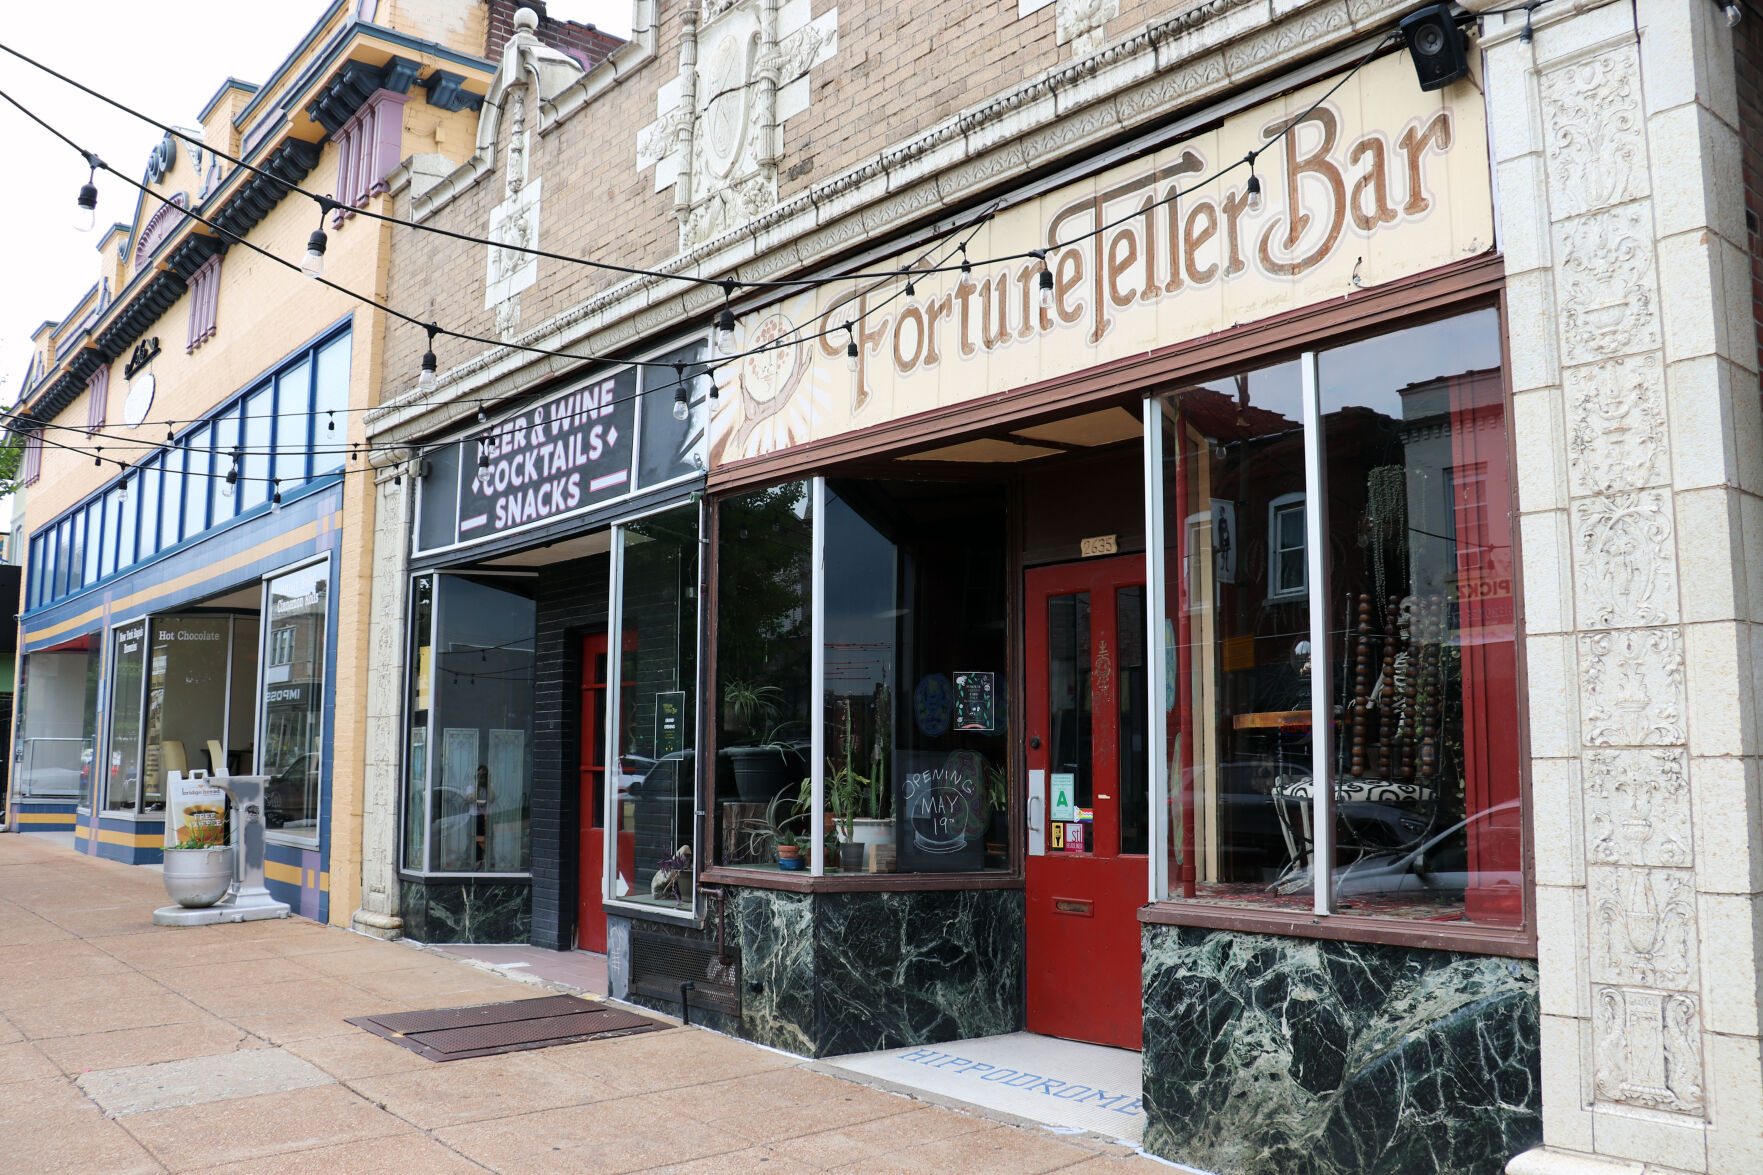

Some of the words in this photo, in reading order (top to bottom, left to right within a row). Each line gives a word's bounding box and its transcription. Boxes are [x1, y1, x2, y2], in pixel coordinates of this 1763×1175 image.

[1258, 105, 1451, 276] Bar
[477, 417, 528, 464] BEER
[531, 407, 546, 447] &
[551, 379, 615, 436] WINE
[483, 425, 603, 496] COCKTAILS
[495, 472, 580, 529] SNACKS
[1084, 537, 1113, 555] 2635
[158, 630, 175, 641] Hot
[177, 630, 220, 641] Chocolate
[902, 769, 975, 799] OPENING
[1057, 791, 1068, 807] A
[194, 812, 216, 820] FREE
[921, 795, 959, 815] MAY
[897, 1048, 1143, 1116] HIPPODROME
